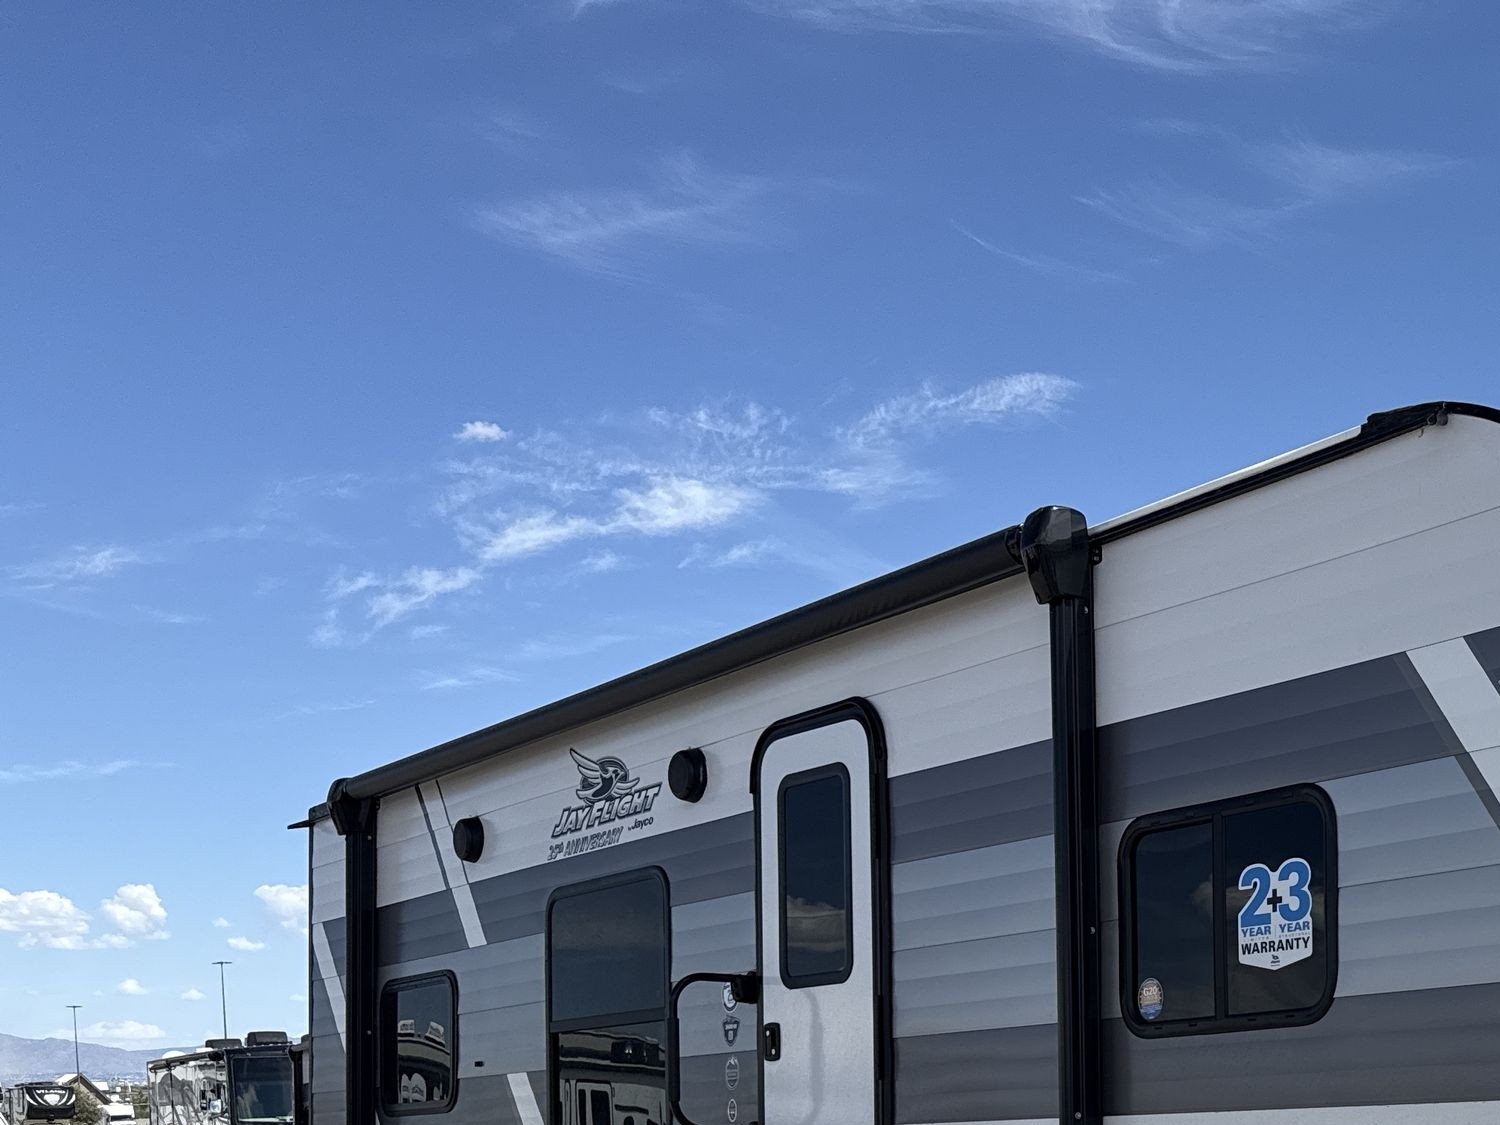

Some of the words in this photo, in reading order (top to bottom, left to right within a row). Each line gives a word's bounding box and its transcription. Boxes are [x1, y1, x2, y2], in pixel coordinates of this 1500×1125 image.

[551, 804, 591, 838] JAY
[588, 782, 662, 825] FLIGHT
[1241, 926, 1271, 938] YEAR
[1279, 921, 1311, 933] YEAR
[1241, 936, 1311, 955] WARRANTY
